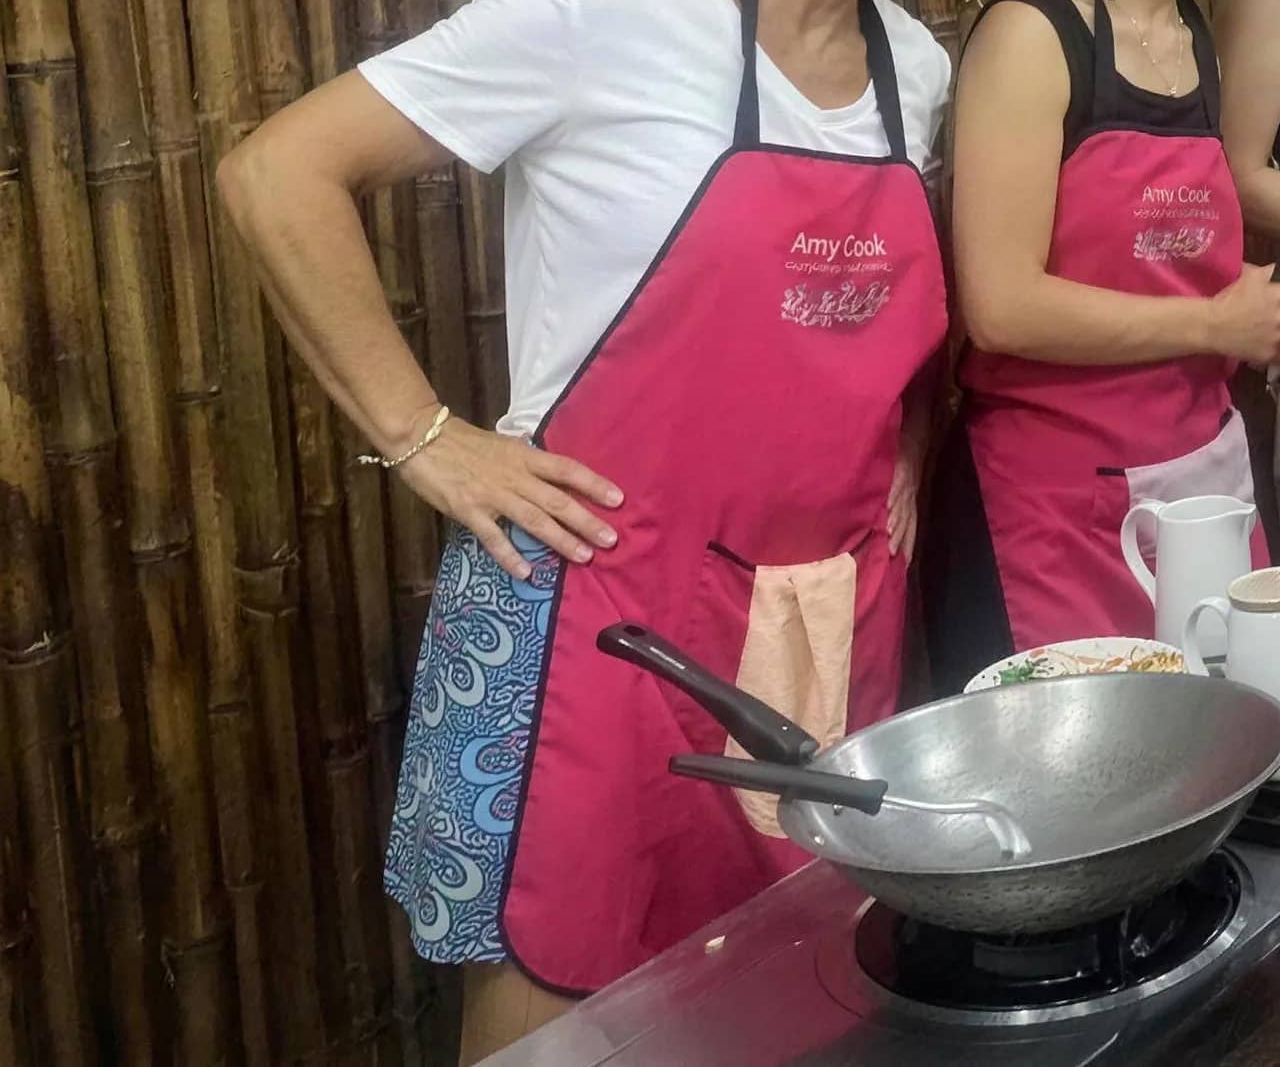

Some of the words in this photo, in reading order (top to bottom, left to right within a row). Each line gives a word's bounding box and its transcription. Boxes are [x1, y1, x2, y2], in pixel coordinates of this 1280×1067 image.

[1178, 184, 1212, 203] Cook
[790, 231, 841, 263] Amy
[843, 232, 887, 257] Cook
